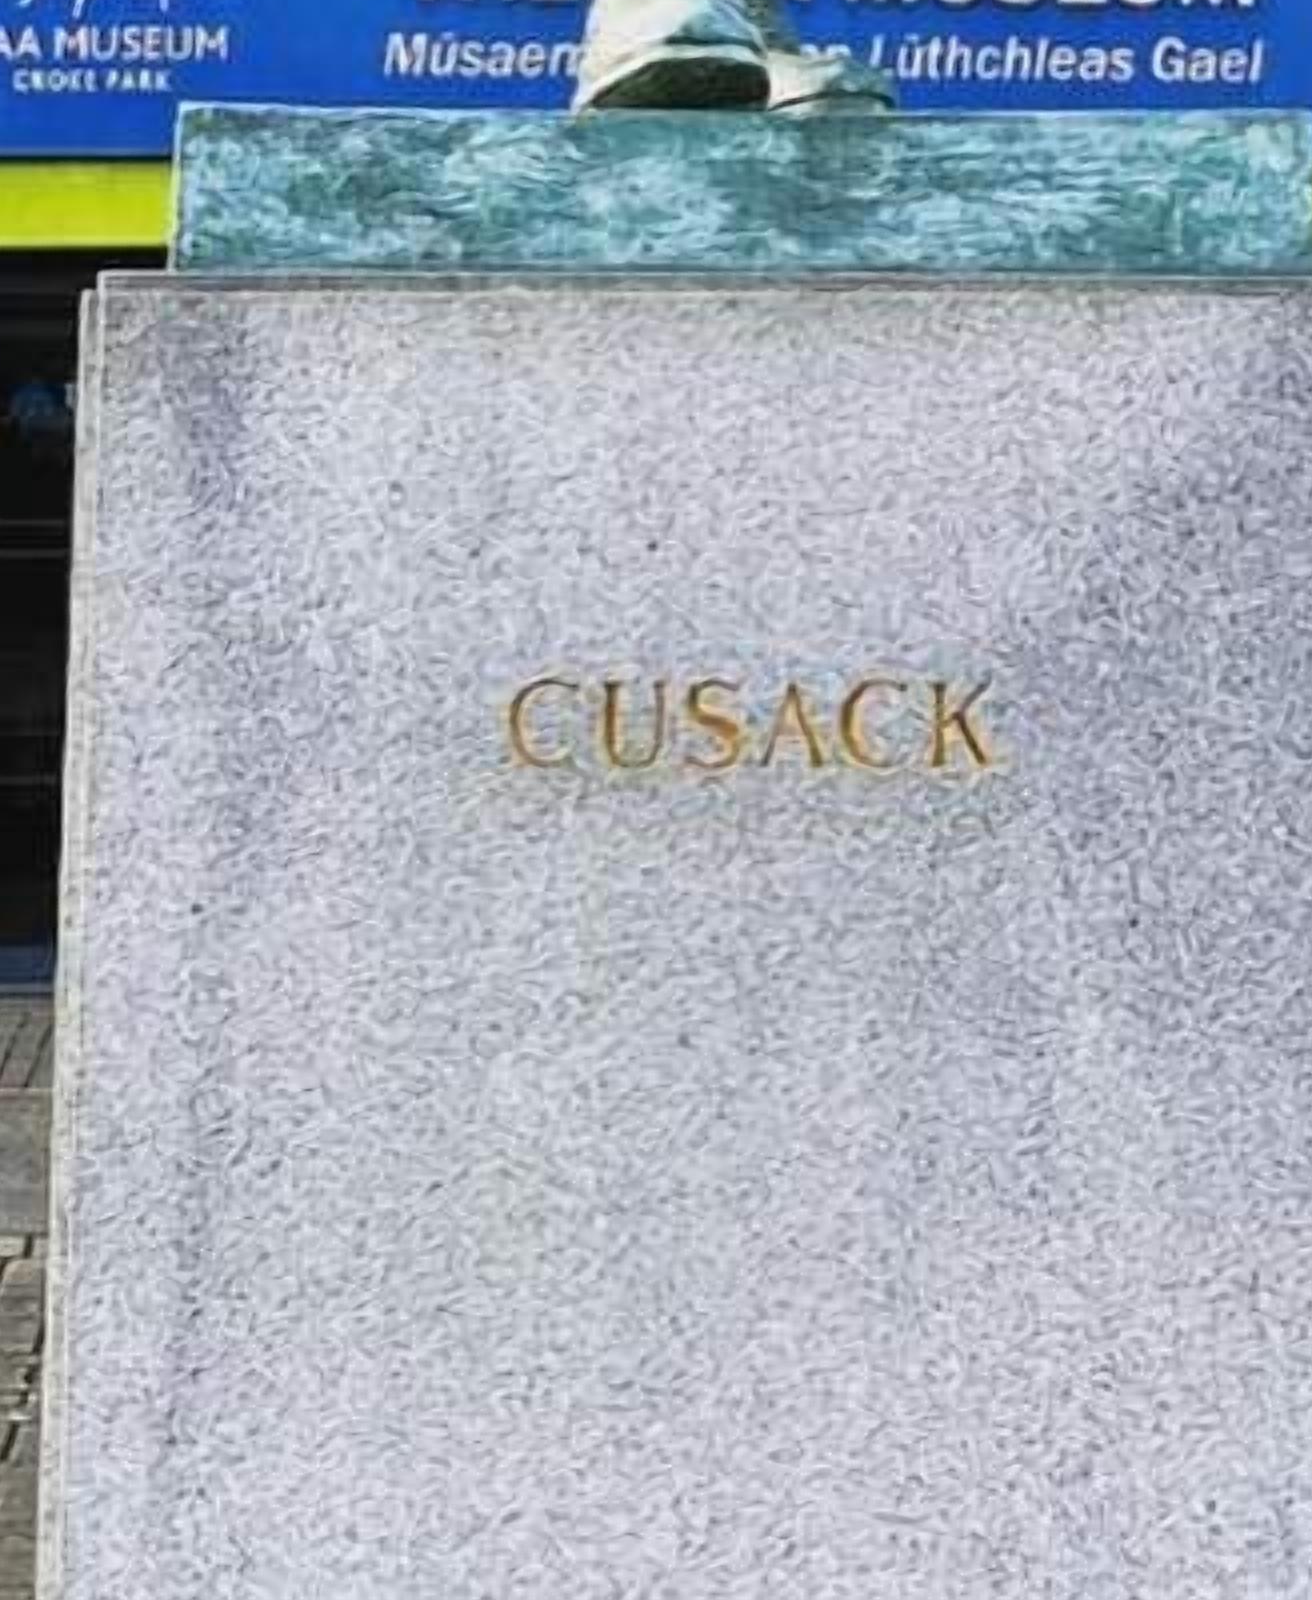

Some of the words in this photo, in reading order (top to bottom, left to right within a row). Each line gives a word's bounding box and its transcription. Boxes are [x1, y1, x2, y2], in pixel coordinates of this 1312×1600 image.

[53, 25, 230, 63] MUSEUM
[1152, 36, 1263, 85] Gael
[507, 676, 993, 770] CUSACK
